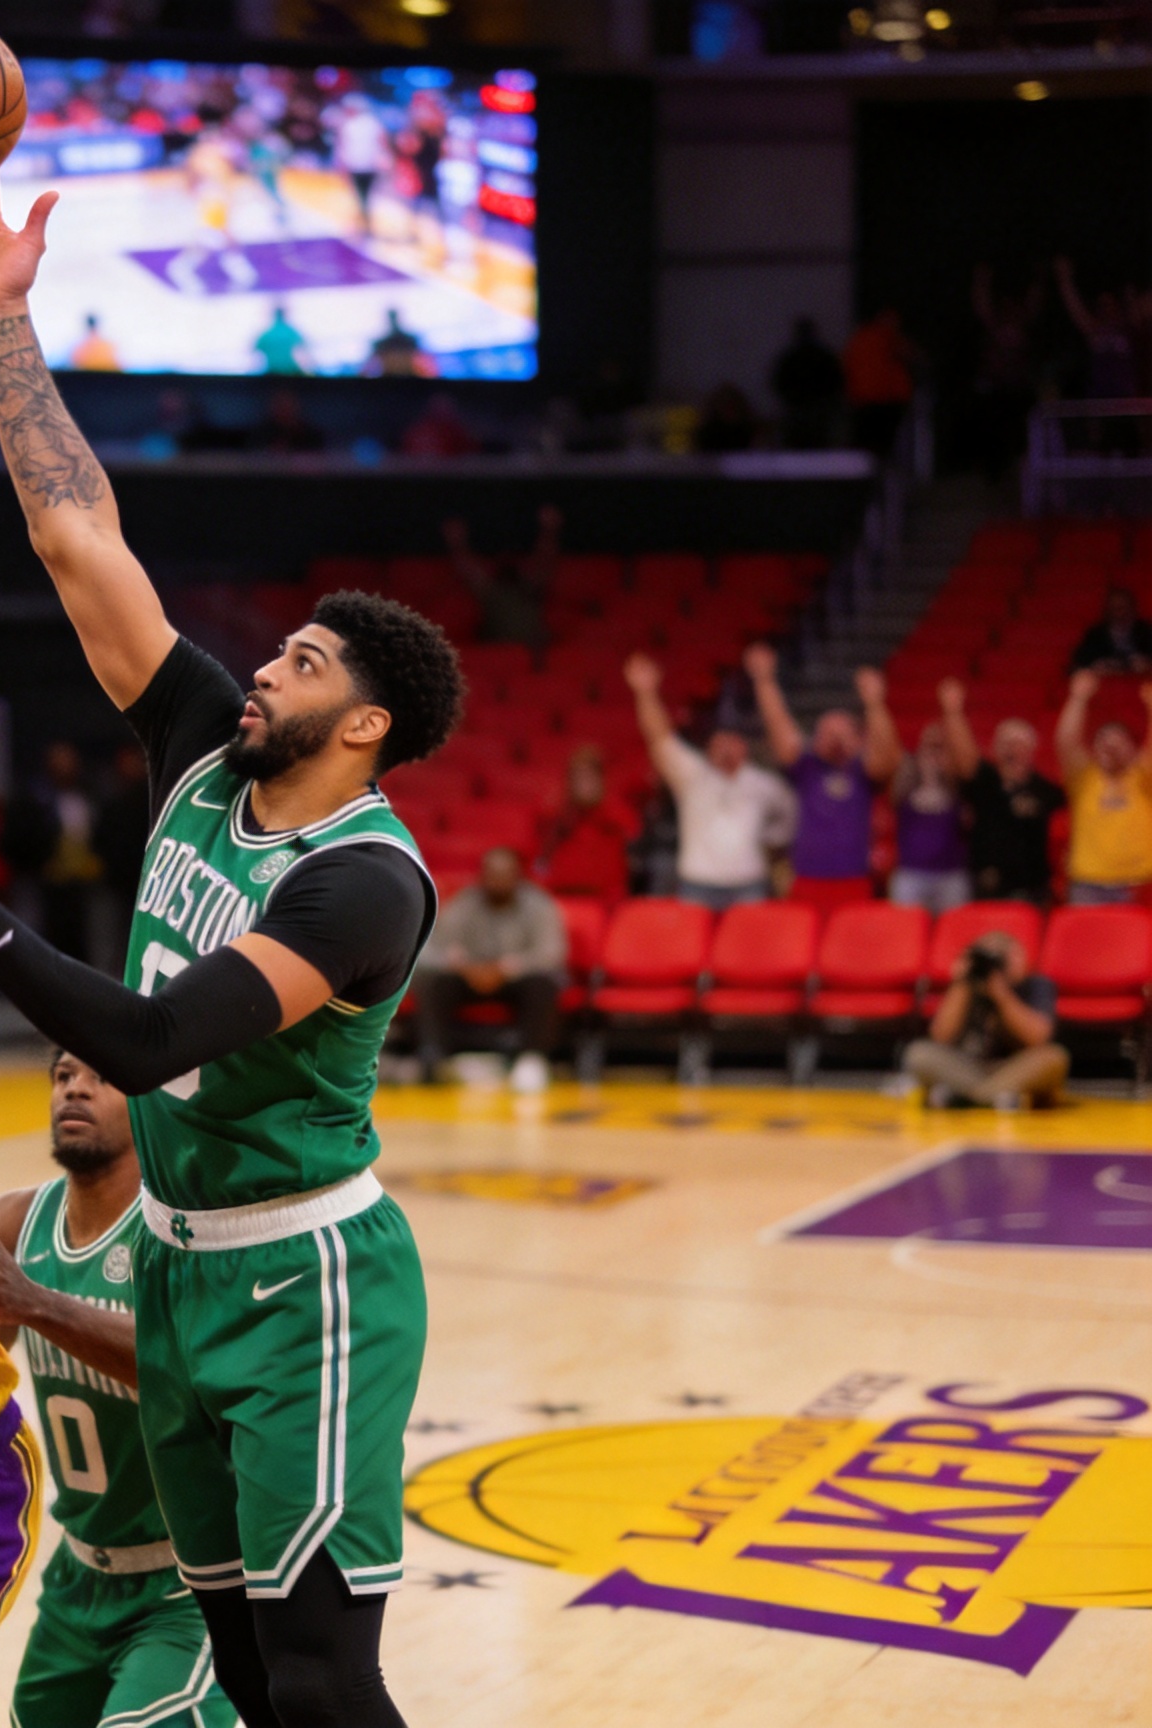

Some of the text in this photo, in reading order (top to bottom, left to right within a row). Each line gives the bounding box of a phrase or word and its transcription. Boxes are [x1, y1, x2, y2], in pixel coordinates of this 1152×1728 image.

[137, 837, 258, 957] BOSTON
[46, 1394, 110, 1495] 0
[562, 1381, 1150, 1678] LAKERS
